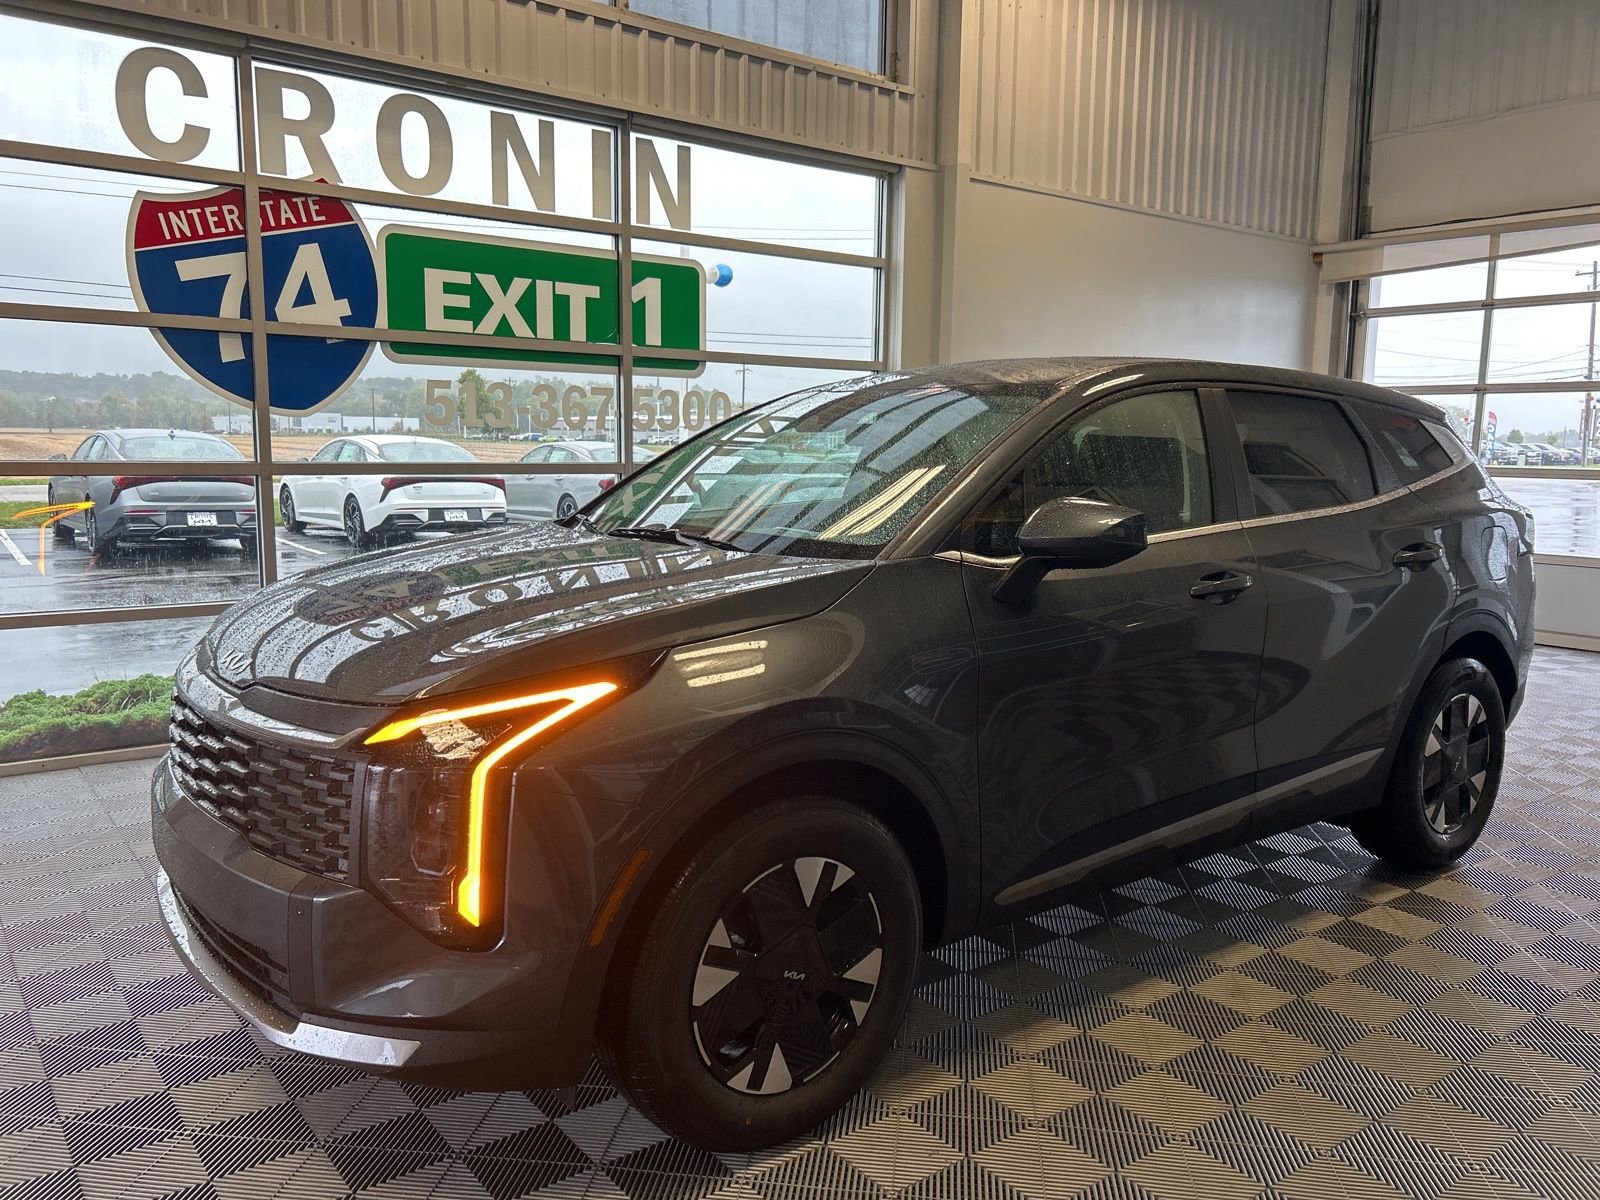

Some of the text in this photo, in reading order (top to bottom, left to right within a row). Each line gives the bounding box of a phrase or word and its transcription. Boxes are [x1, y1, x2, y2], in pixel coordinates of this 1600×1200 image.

[115, 46, 692, 231] CRONIN
[158, 196, 326, 240] INTERTATE
[174, 242, 352, 363] 74
[424, 267, 662, 346] EXIT 1
[424, 379, 732, 432] 513-3675300
